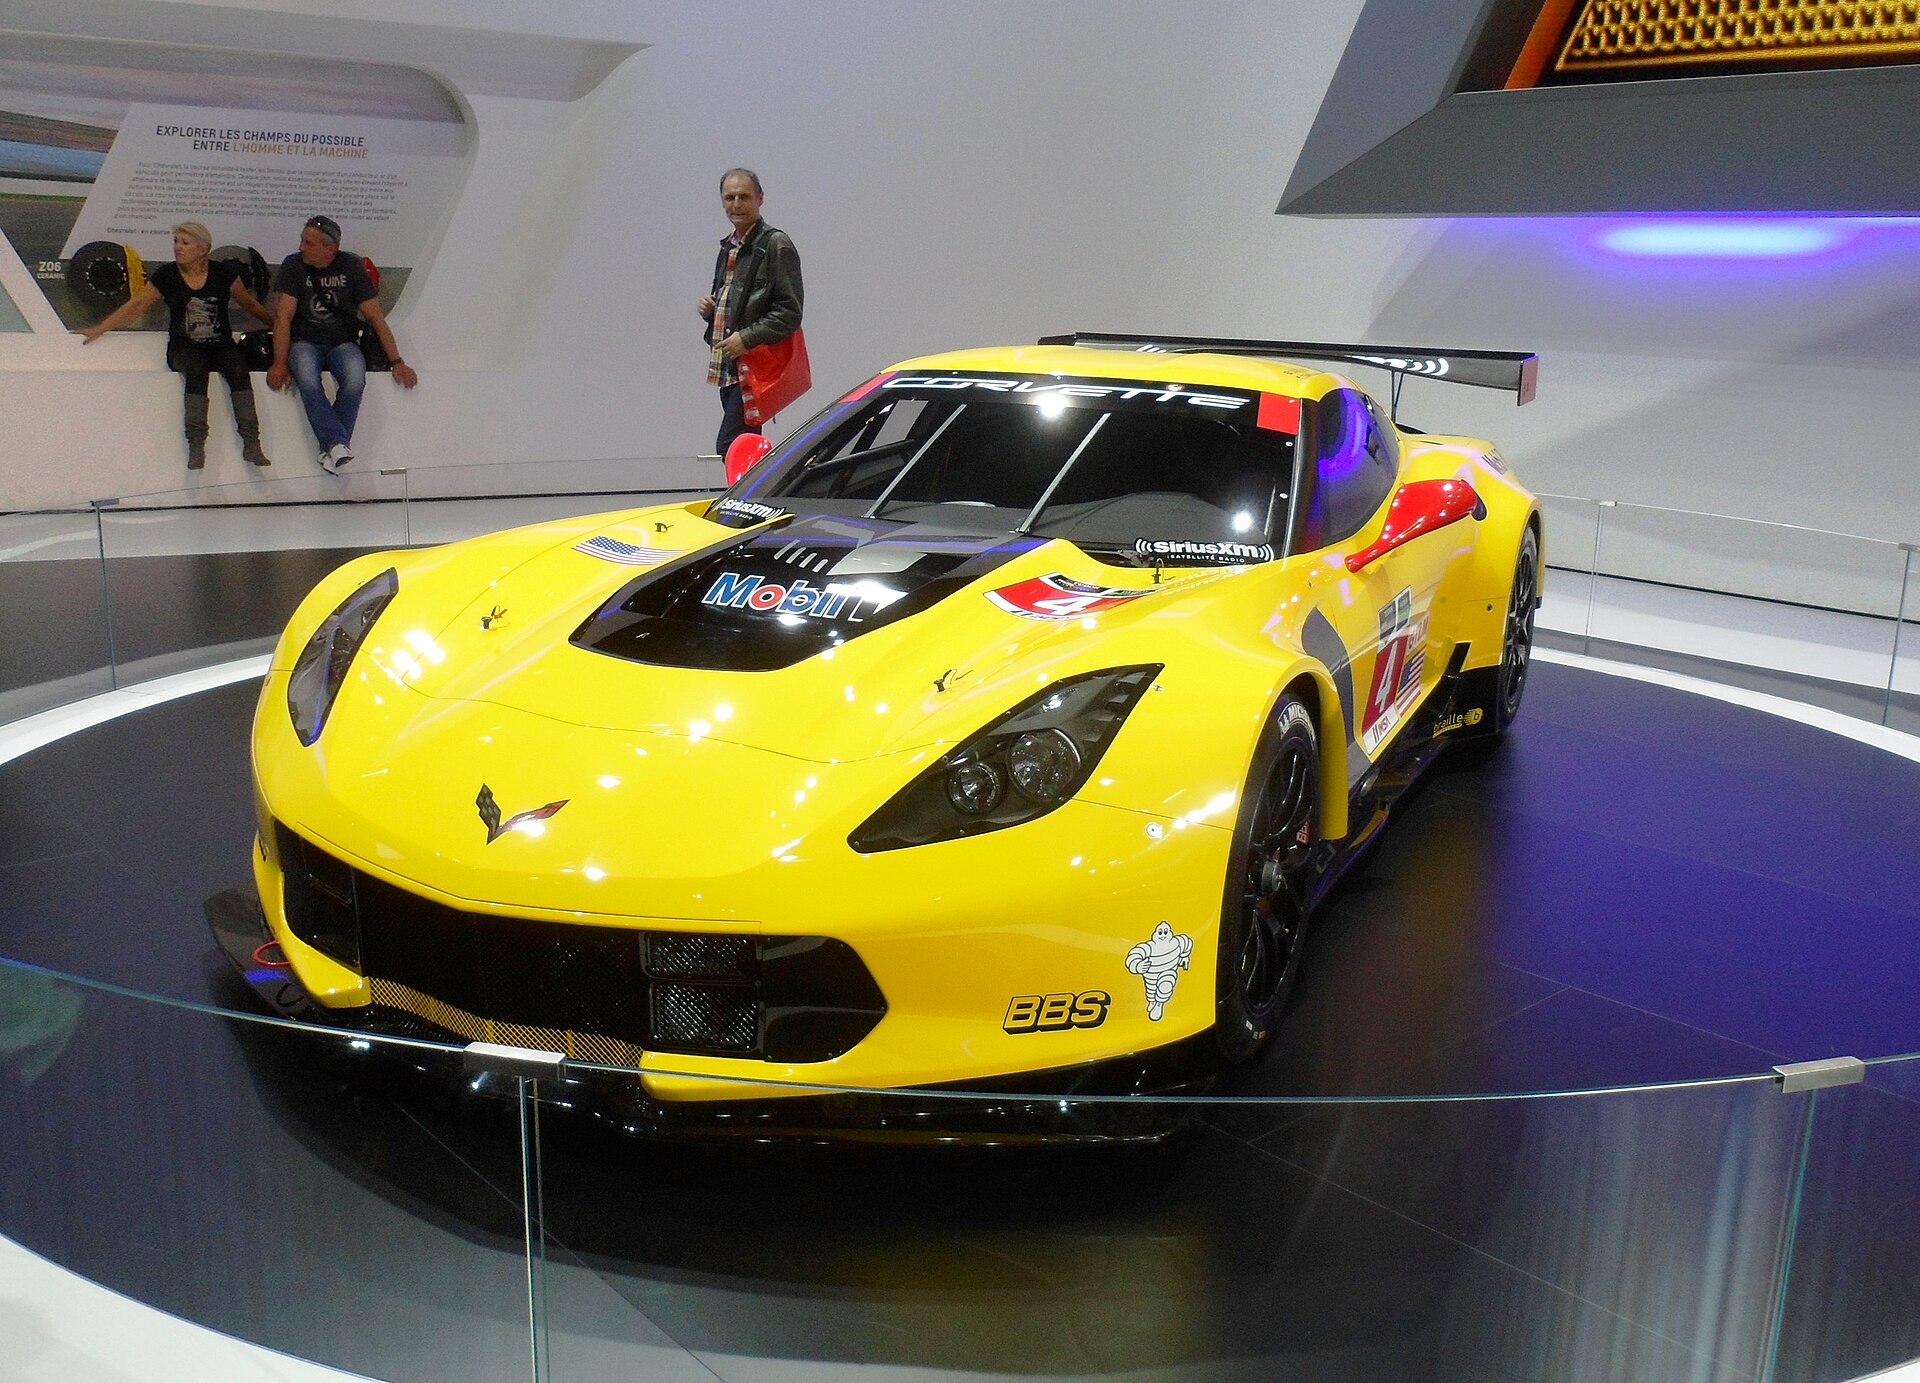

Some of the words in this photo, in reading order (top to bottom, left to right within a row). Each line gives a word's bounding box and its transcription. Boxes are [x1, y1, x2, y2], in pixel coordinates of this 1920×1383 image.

[156, 125, 216, 138] EXPLORER
[219, 129, 241, 140] LES
[243, 130, 291, 143] CHAMPS
[293, 133, 309, 144] DU
[311, 134, 365, 147] POSSIBLE
[193, 140, 230, 151] ENTRE
[233, 141, 284, 154] L'HOMME
[286, 144, 300, 155] ET
[303, 146, 316, 157] LA
[319, 147, 369, 159] MACHINE
[38, 261, 62, 272] Z06
[882, 377, 1250, 409] CORVETTE
[1031, 597, 1104, 616] 4
[1375, 640, 1398, 713] 4
[1002, 990, 1112, 1035] BBS
